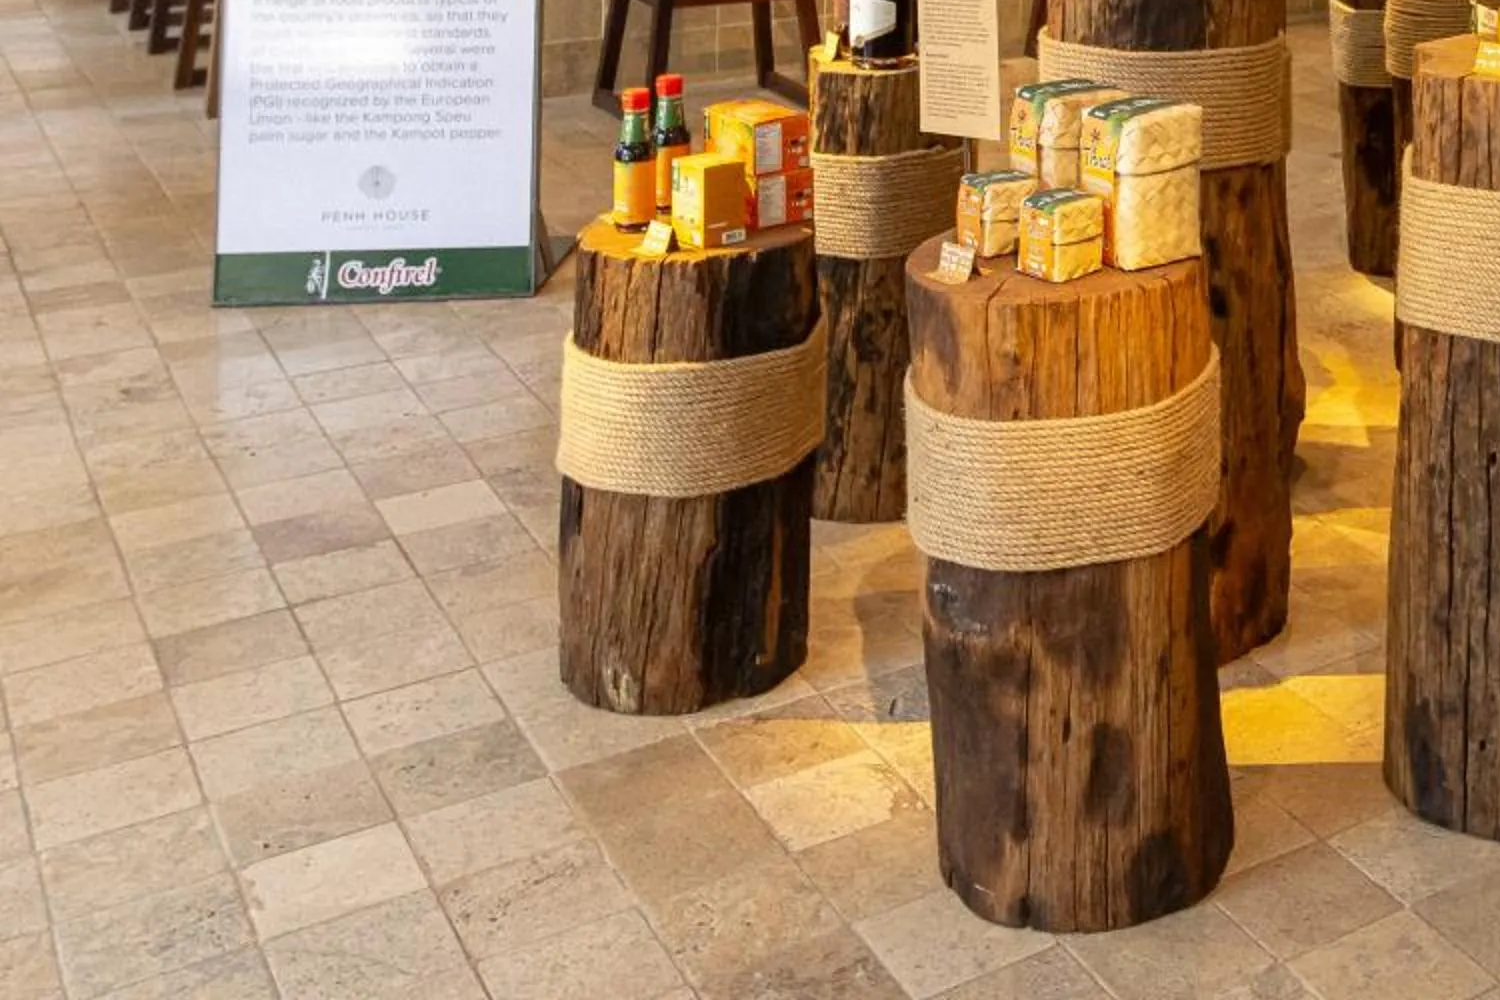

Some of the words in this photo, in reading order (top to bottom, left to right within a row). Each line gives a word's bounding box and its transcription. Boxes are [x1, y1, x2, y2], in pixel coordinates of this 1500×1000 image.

[447, 11, 473, 23] that
[477, 11, 508, 25] they
[460, 46, 496, 56] were
[421, 61, 465, 73] obtain
[250, 79, 321, 90] Protected
[325, 79, 422, 93] Geographical
[426, 78, 494, 89] Indication
[288, 97, 369, 110] recognized
[373, 95, 390, 109] by
[394, 95, 417, 107] the
[422, 94, 491, 109] European
[250, 112, 293, 124] Union
[335, 112, 360, 123] the
[363, 112, 431, 126] Kampong
[435, 111, 472, 125] Speu
[249, 130, 285, 144] palm
[289, 131, 329, 144] sugar
[333, 129, 361, 140] and
[364, 129, 388, 140] the
[391, 128, 446, 143] Kampot
[321, 210, 366, 222] PENH
[373, 209, 432, 222] HOUSE
[338, 257, 438, 294] Confirel
